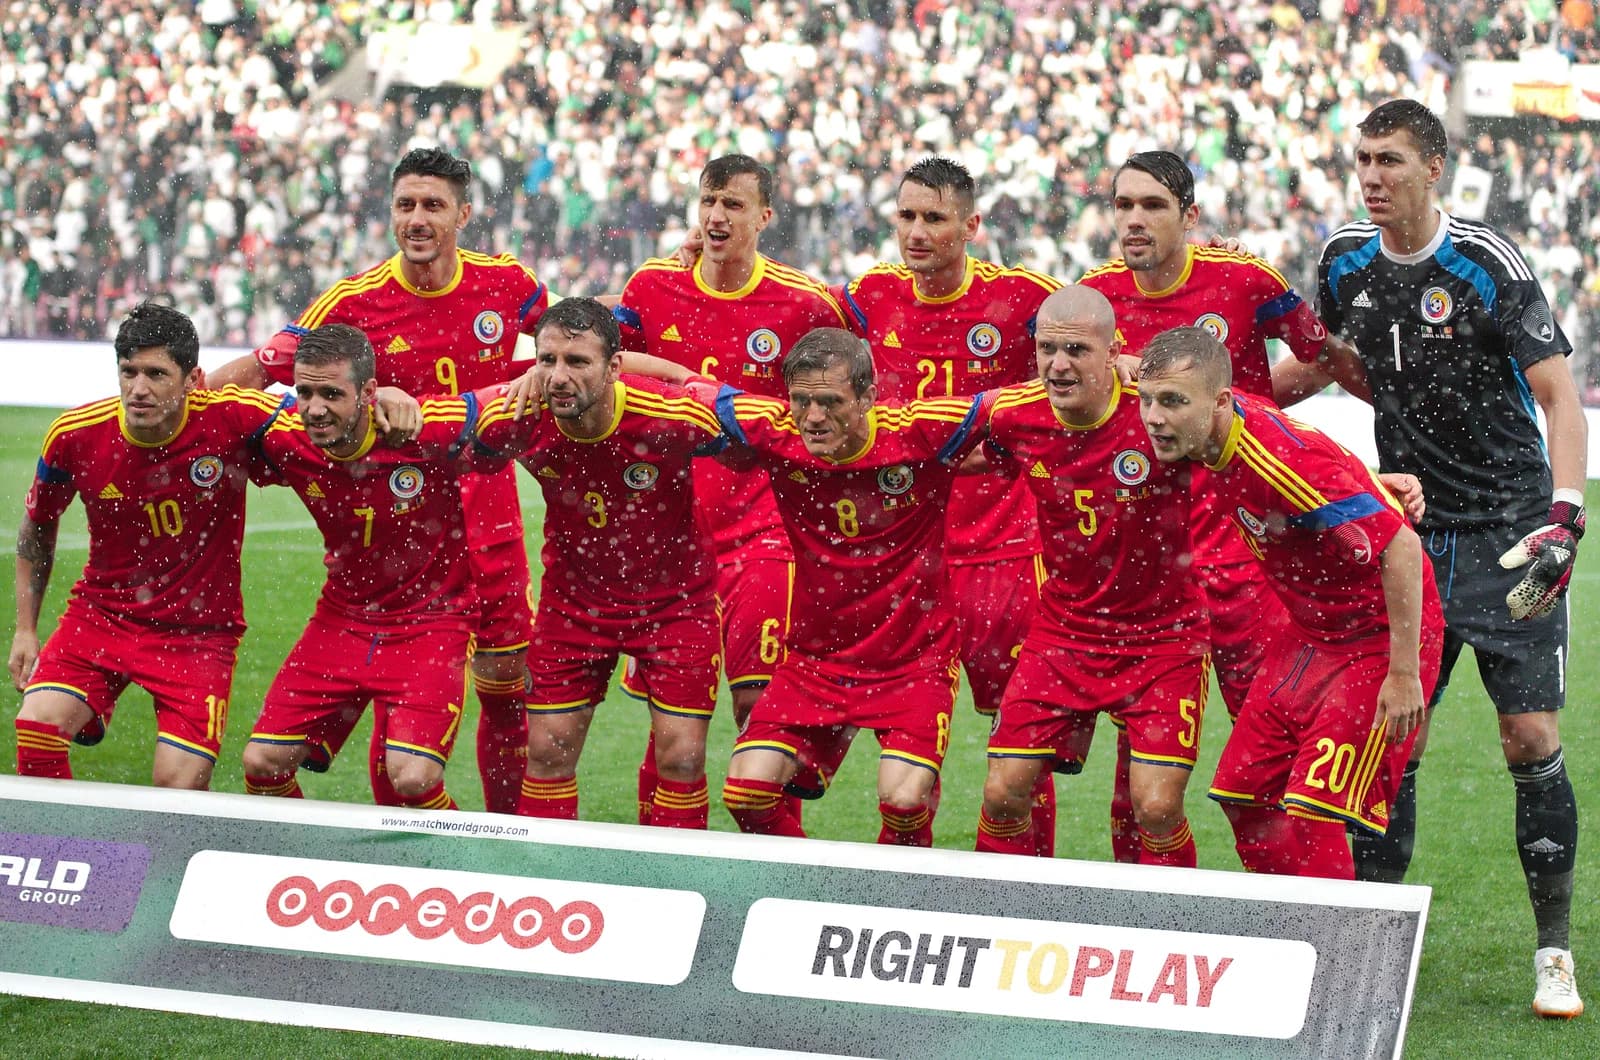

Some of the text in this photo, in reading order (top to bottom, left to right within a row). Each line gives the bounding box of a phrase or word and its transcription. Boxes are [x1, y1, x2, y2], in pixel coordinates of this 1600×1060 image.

[1389, 324, 1402, 371] 1
[436, 357, 457, 395] 9
[917, 359, 953, 400] 21
[144, 500, 182, 537] 10
[354, 508, 374, 547] 7
[584, 492, 607, 528] 3
[837, 499, 859, 537] 8
[1074, 489, 1097, 536] 5
[761, 618, 779, 664] 6
[1553, 646, 1563, 693] 1
[440, 703, 460, 746] 7
[937, 712, 949, 757] 8
[1178, 699, 1195, 748] 5
[1305, 737, 1356, 793] 20
[381, 817, 529, 837] www.matchworldgroup.com
[19, 889, 81, 906] GROUP
[272, 880, 599, 948] ooredoo
[811, 925, 1234, 1008] RIGHT TO PLAY
